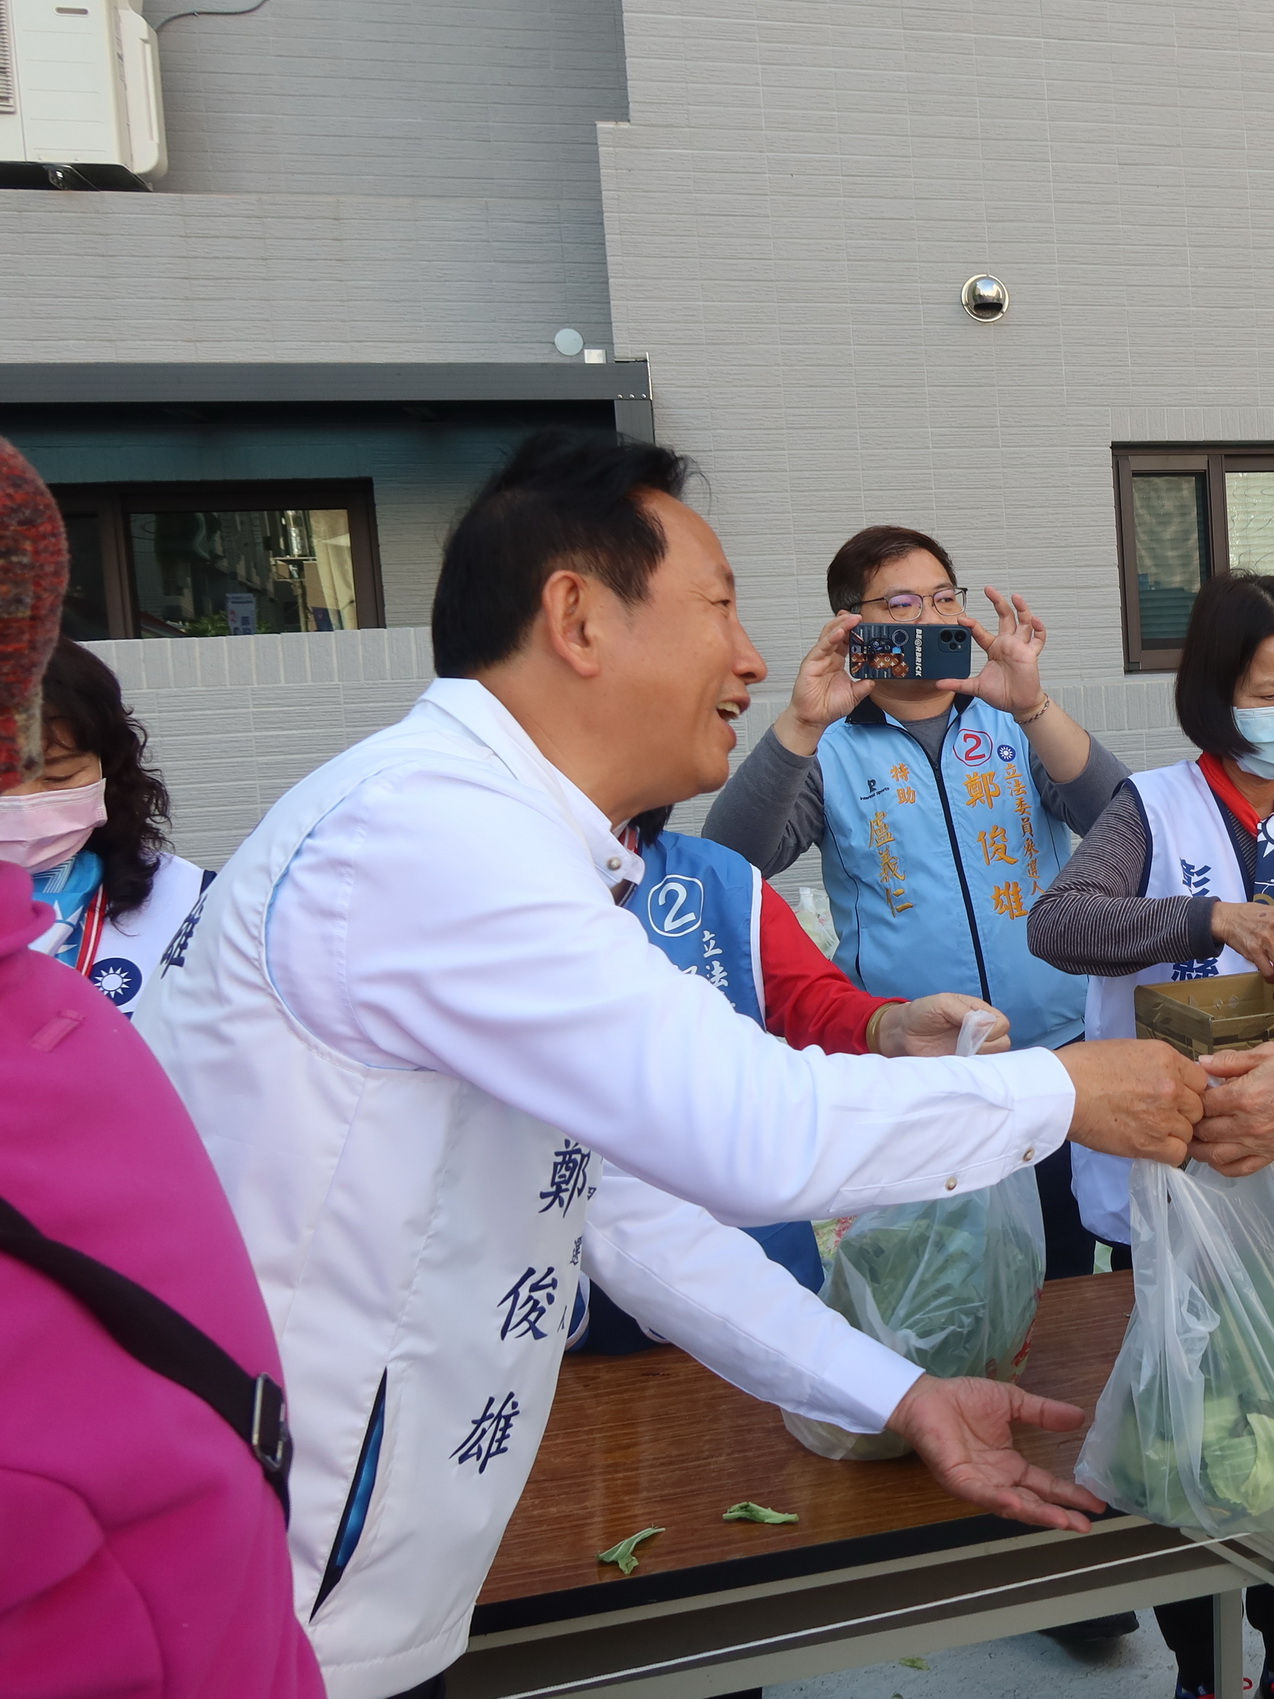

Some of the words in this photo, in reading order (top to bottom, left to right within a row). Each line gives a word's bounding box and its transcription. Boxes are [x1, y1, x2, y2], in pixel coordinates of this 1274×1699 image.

[890, 763, 916, 804] 特助
[963, 732, 987, 762] 2
[867, 810, 914, 918] 盧義仁
[963, 769, 1029, 921] 鄭俊雄
[658, 882, 697, 932] 2
[448, 1138, 592, 1474] 鄭俊雄
